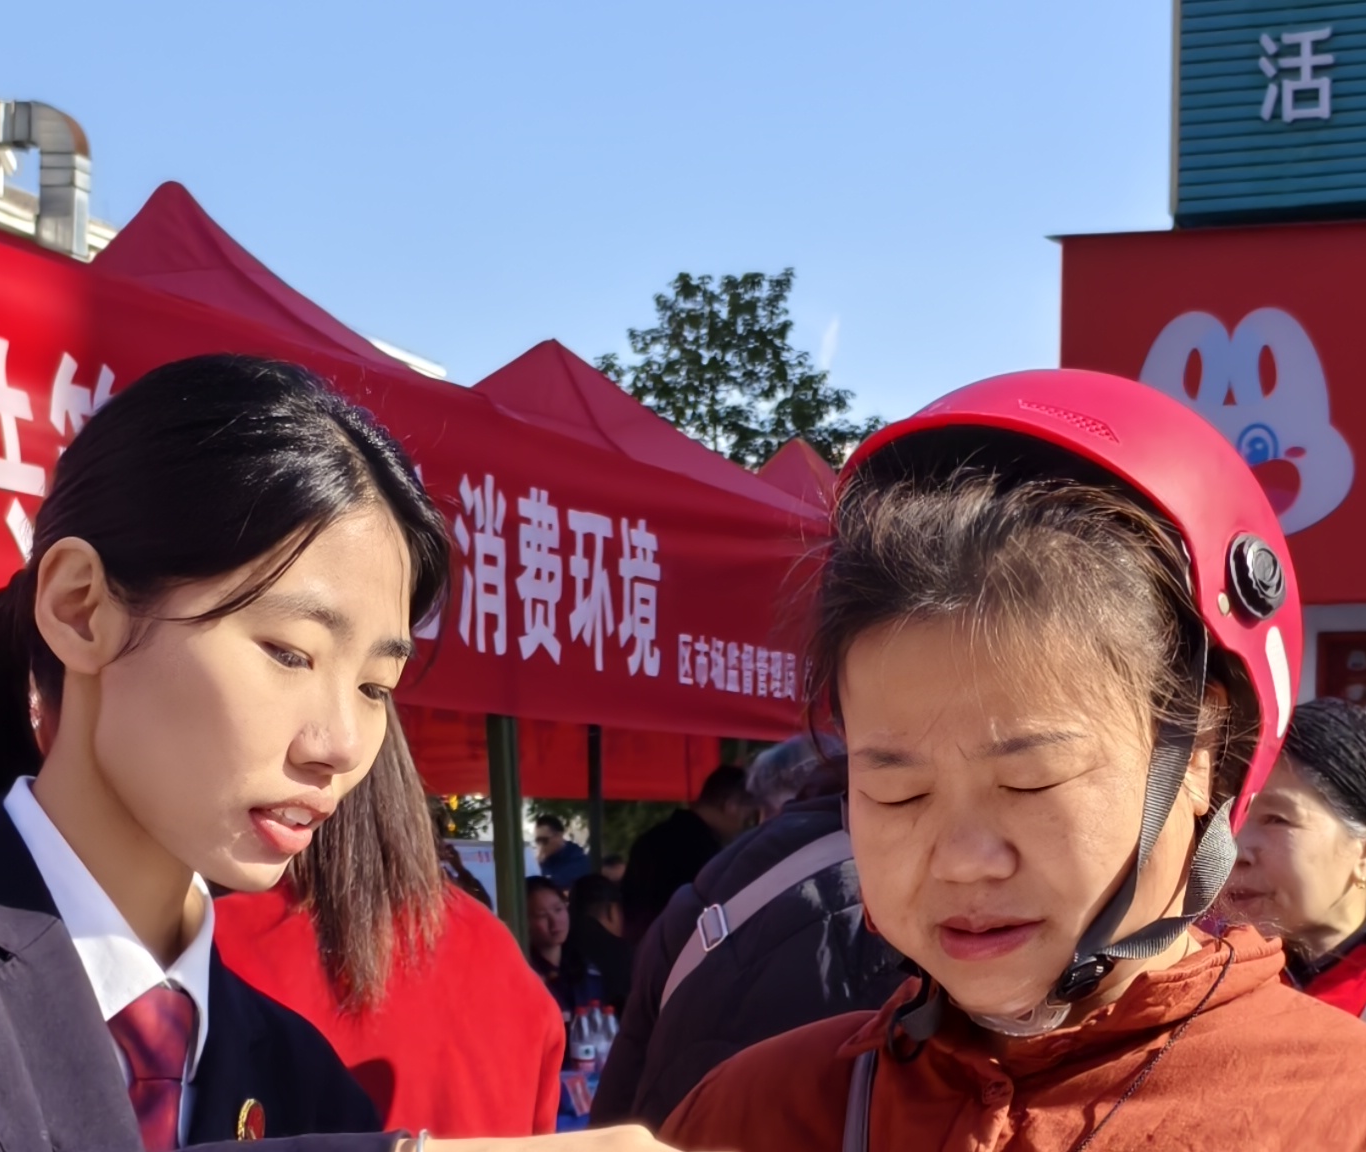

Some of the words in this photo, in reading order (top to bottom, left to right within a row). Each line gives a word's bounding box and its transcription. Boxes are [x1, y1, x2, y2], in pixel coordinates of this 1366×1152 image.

[1259, 26, 1335, 124] 活
[413, 463, 662, 678] 消费环境
